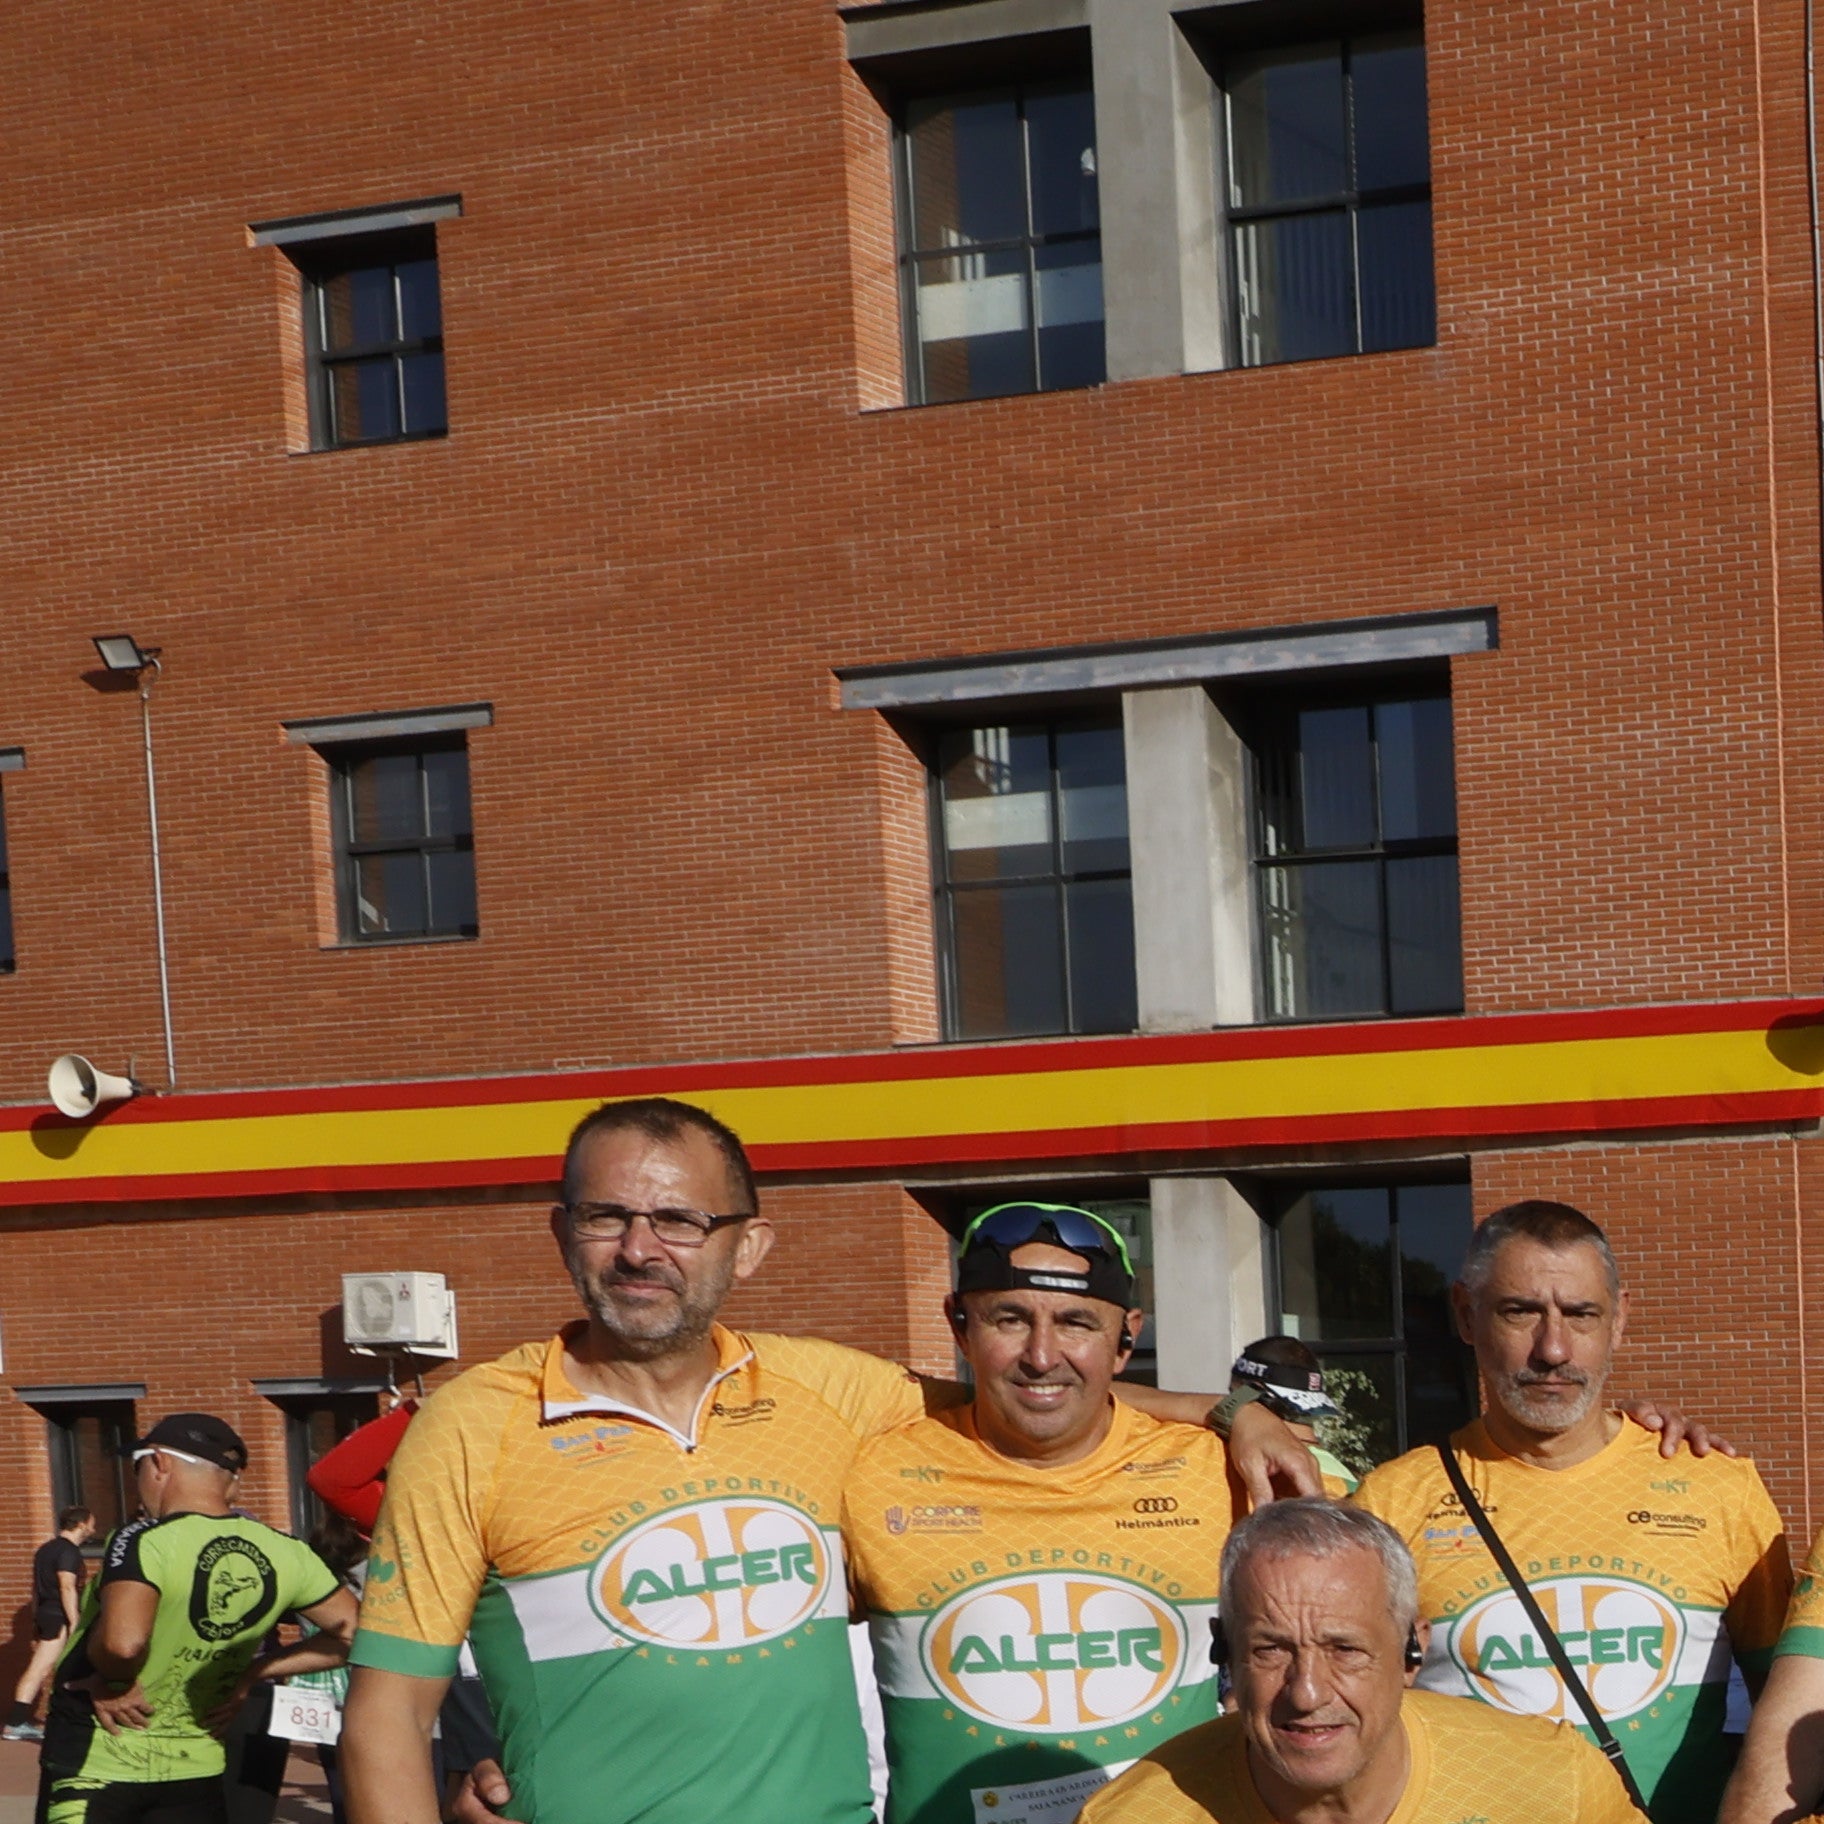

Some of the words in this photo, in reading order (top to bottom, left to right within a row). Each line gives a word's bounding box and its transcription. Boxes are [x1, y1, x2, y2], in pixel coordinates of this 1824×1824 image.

[580, 1500, 645, 1553] CLUB
[660, 1477, 820, 1516] DEPORTIVO
[1115, 1516, 1200, 1529] Helmántica
[1651, 1513, 1707, 1529] consulting
[621, 1542, 818, 1608] ALCER
[915, 1560, 988, 1608] CLUB
[1007, 1548, 1183, 1598] DEPORTIVO
[1443, 1571, 1507, 1613] CLUB
[1528, 1555, 1688, 1602] DEPORTIVO
[949, 1627, 1165, 1674] ALCER
[1477, 1625, 1665, 1672] ALCER
[290, 1705, 333, 1729] 831
